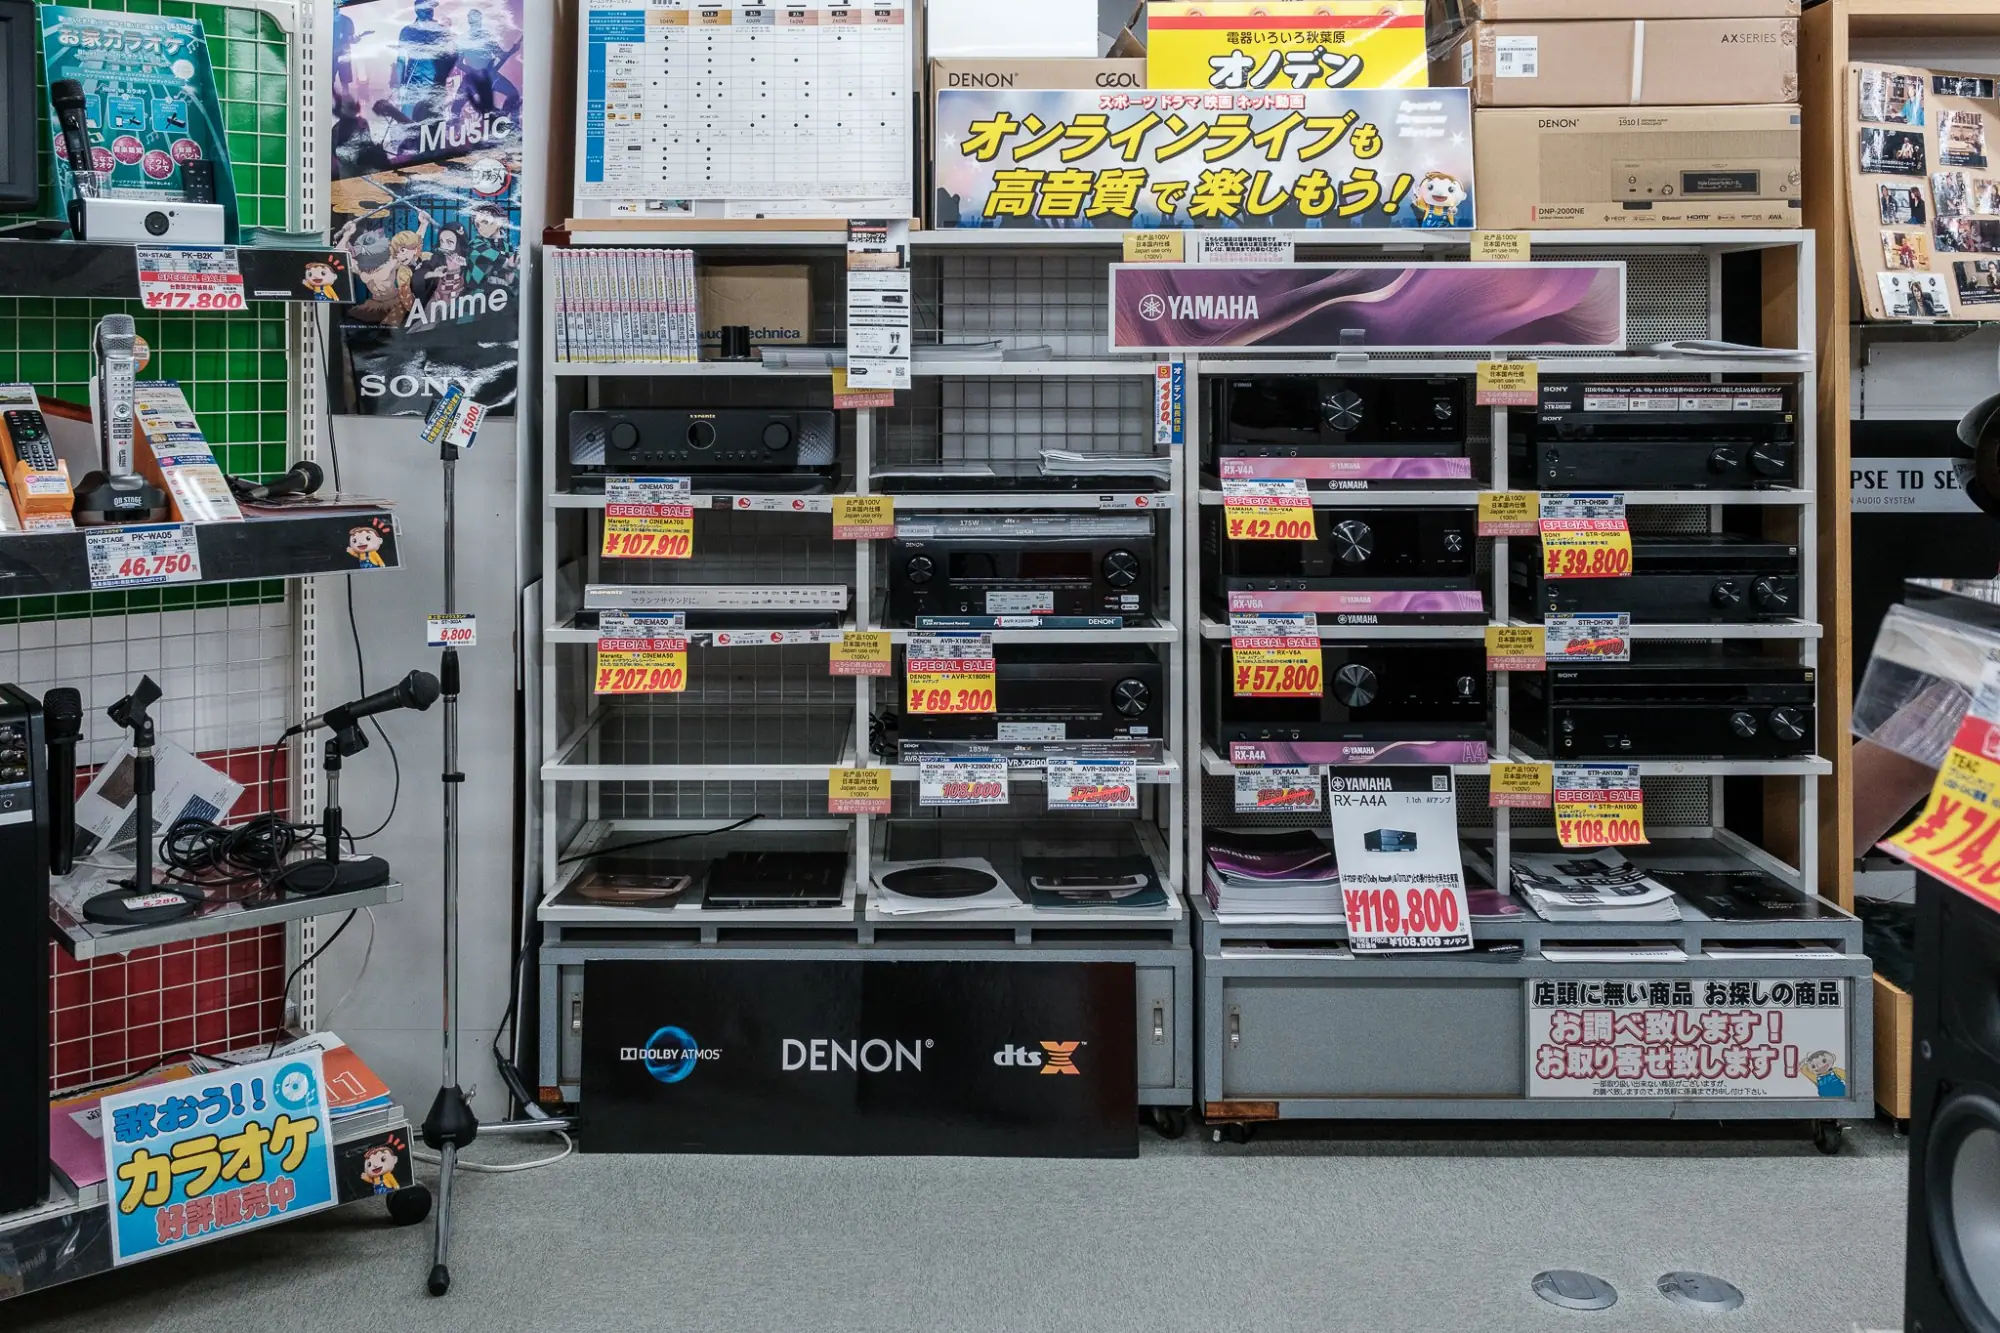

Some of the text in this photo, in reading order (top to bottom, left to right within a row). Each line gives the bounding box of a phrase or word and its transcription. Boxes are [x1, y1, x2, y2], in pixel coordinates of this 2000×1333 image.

[58, 28, 185, 55] お家カラオケ
[1226, 30, 1346, 44] 電器いろいろ秋葉原
[1208, 46, 1365, 89] オノデン
[949, 73, 1014, 88] DENON
[1099, 94, 1306, 110] スポーツ ドラマ 映画 ネット動画
[1538, 119, 1577, 128] DENON
[420, 114, 511, 154] Music
[960, 110, 1383, 164] オンラインライブも
[182, 252, 213, 260] PK-B2K
[158, 274, 228, 282] SPECIAL SALE
[405, 288, 508, 327] Anime
[1168, 296, 1259, 320] YAMAHA
[1224, 466, 1254, 475] RX-V4A
[1338, 480, 1368, 489] YAMAHA
[1850, 470, 1924, 489] PSE TD
[1228, 498, 1310, 506] SPECIAL SALE
[610, 506, 690, 516] SPECIAL SALE
[1544, 521, 1624, 529] SPECIAL SALE
[132, 531, 172, 542] PK-WA05
[606, 533, 689, 556] ¥107,910
[1548, 548, 1628, 573] ¥39,800
[1234, 600, 1263, 608] RX-V6A
[1347, 615, 1378, 624] YAMAHA
[440, 629, 472, 640] 9,800
[602, 640, 684, 650] SPECIAL SALE
[1235, 638, 1318, 647] SPECIAL SALE
[912, 661, 993, 671] SPECIAL SALE
[598, 668, 682, 690] ¥207,900
[1237, 665, 1319, 692] ¥57,800
[910, 689, 992, 711] ¥69,300
[1235, 750, 1266, 760] RX-A4A
[1350, 746, 1375, 754] YAMAHA
[1346, 777, 1392, 791] YAMAHA
[1334, 795, 1387, 806] RX-A4A
[1427, 796, 1451, 804] AVアンプ
[1558, 792, 1640, 800] SPECIAL SALE
[1560, 820, 1640, 843] ¥108,000
[1210, 846, 1261, 860] CATALOG
[1344, 888, 1458, 936] ¥119,800
[1533, 981, 1841, 1006] 店頭に無い商品 お探しの商品
[639, 1049, 720, 1060] DOLBY ATMOS
[782, 1038, 921, 1072] DENON
[118, 1114, 318, 1214] カラオケ
[156, 1176, 295, 1244] 好評販売中
